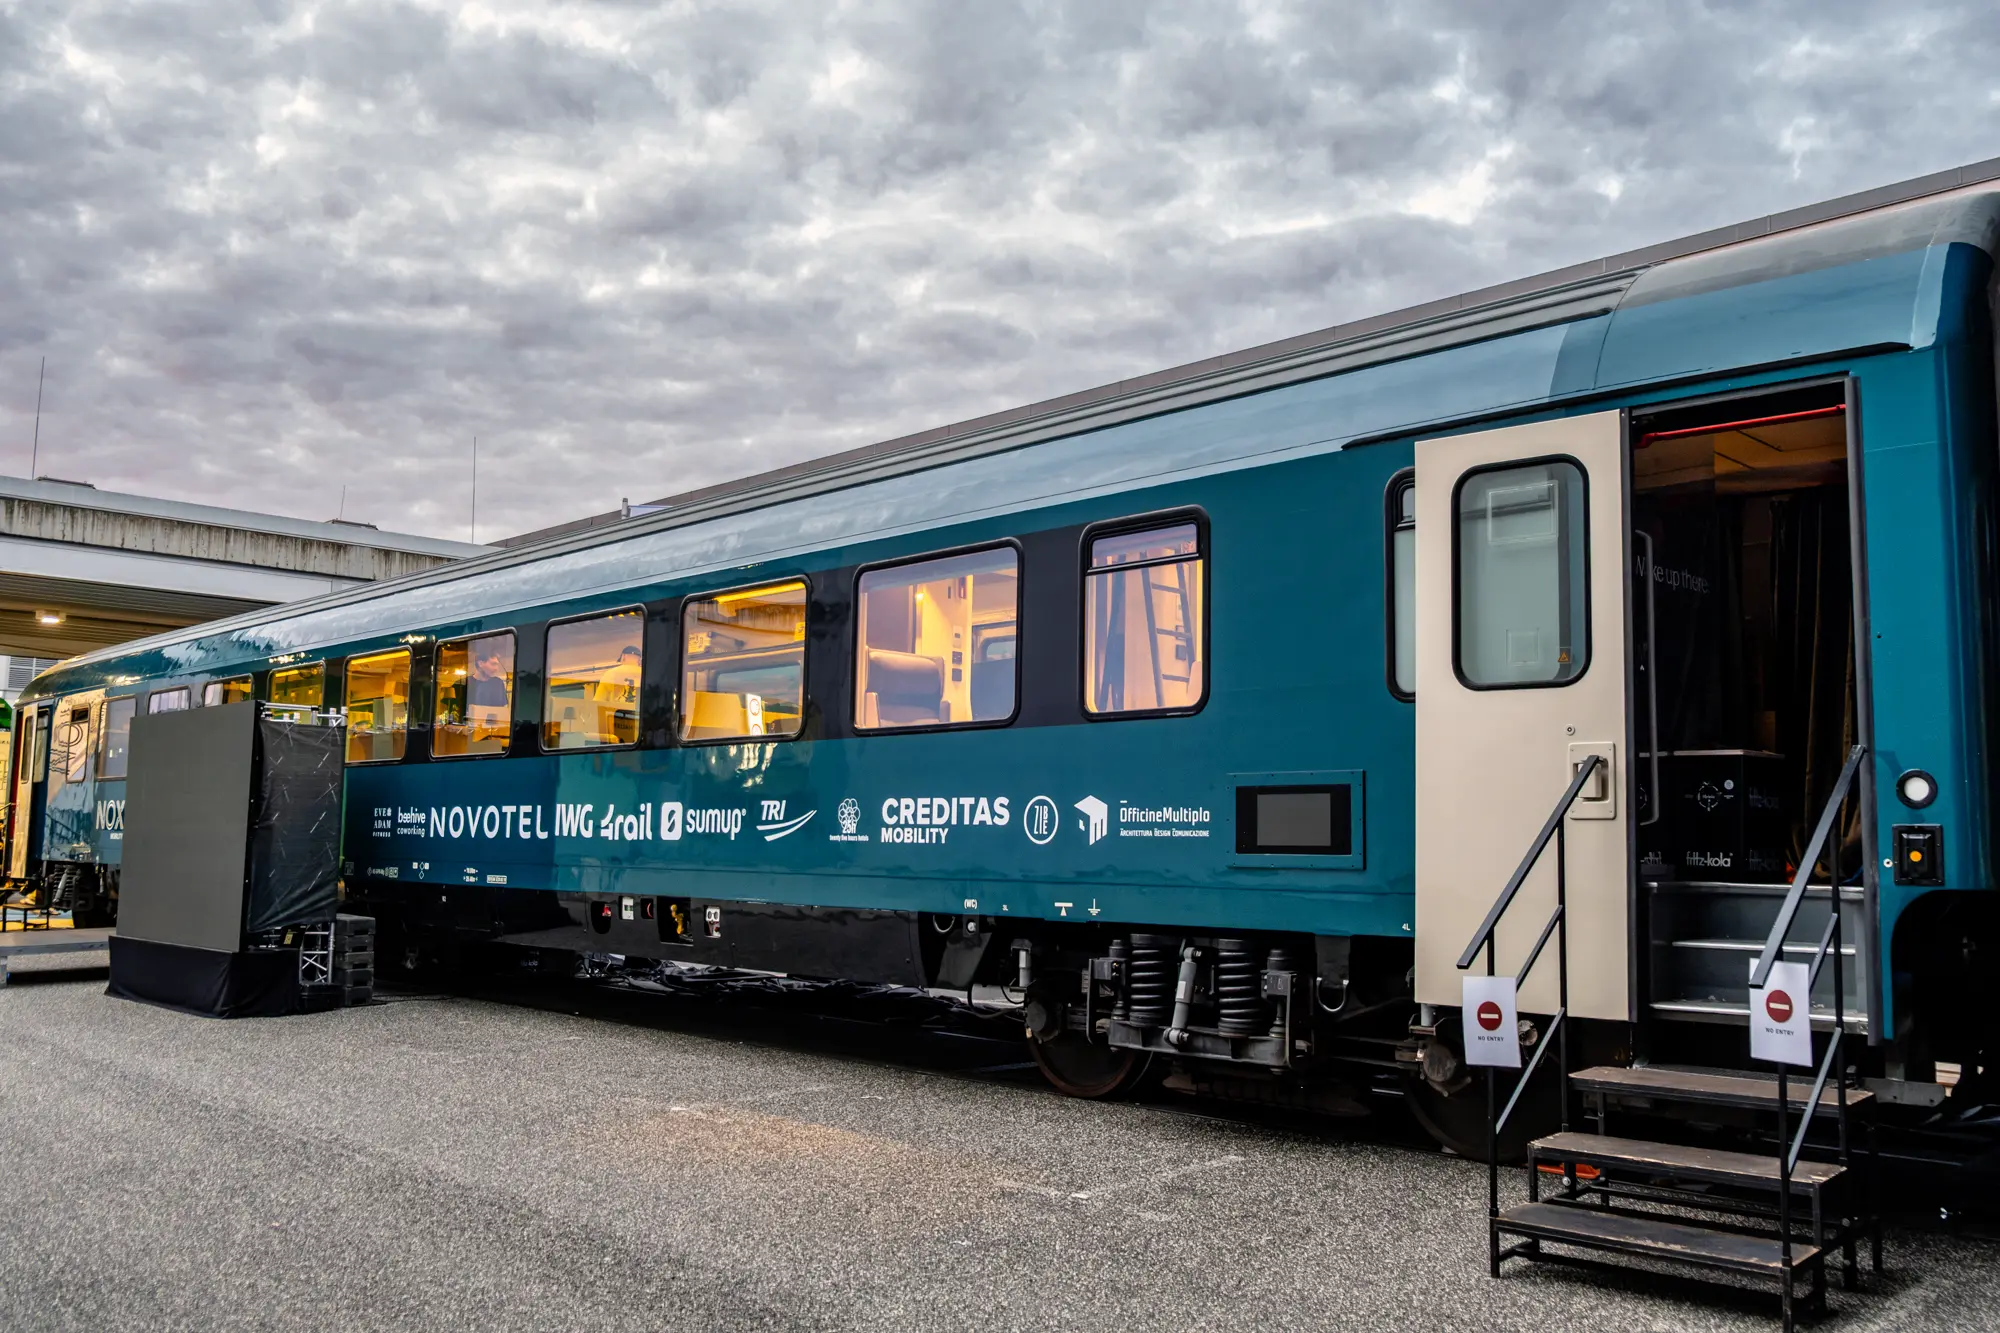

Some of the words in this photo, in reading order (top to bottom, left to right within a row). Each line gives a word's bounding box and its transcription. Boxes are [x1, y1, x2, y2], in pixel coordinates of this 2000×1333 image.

[95, 799, 126, 830] NOX
[398, 806, 426, 824] beehive
[760, 799, 787, 820] TRI
[881, 795, 1010, 825] CREDITAS
[429, 804, 549, 839] NOVOTEL
[554, 803, 594, 838] IWG
[397, 825, 426, 839] coworking
[880, 827, 949, 844] MOBILITY
[1402, 923, 1411, 931] 4L
